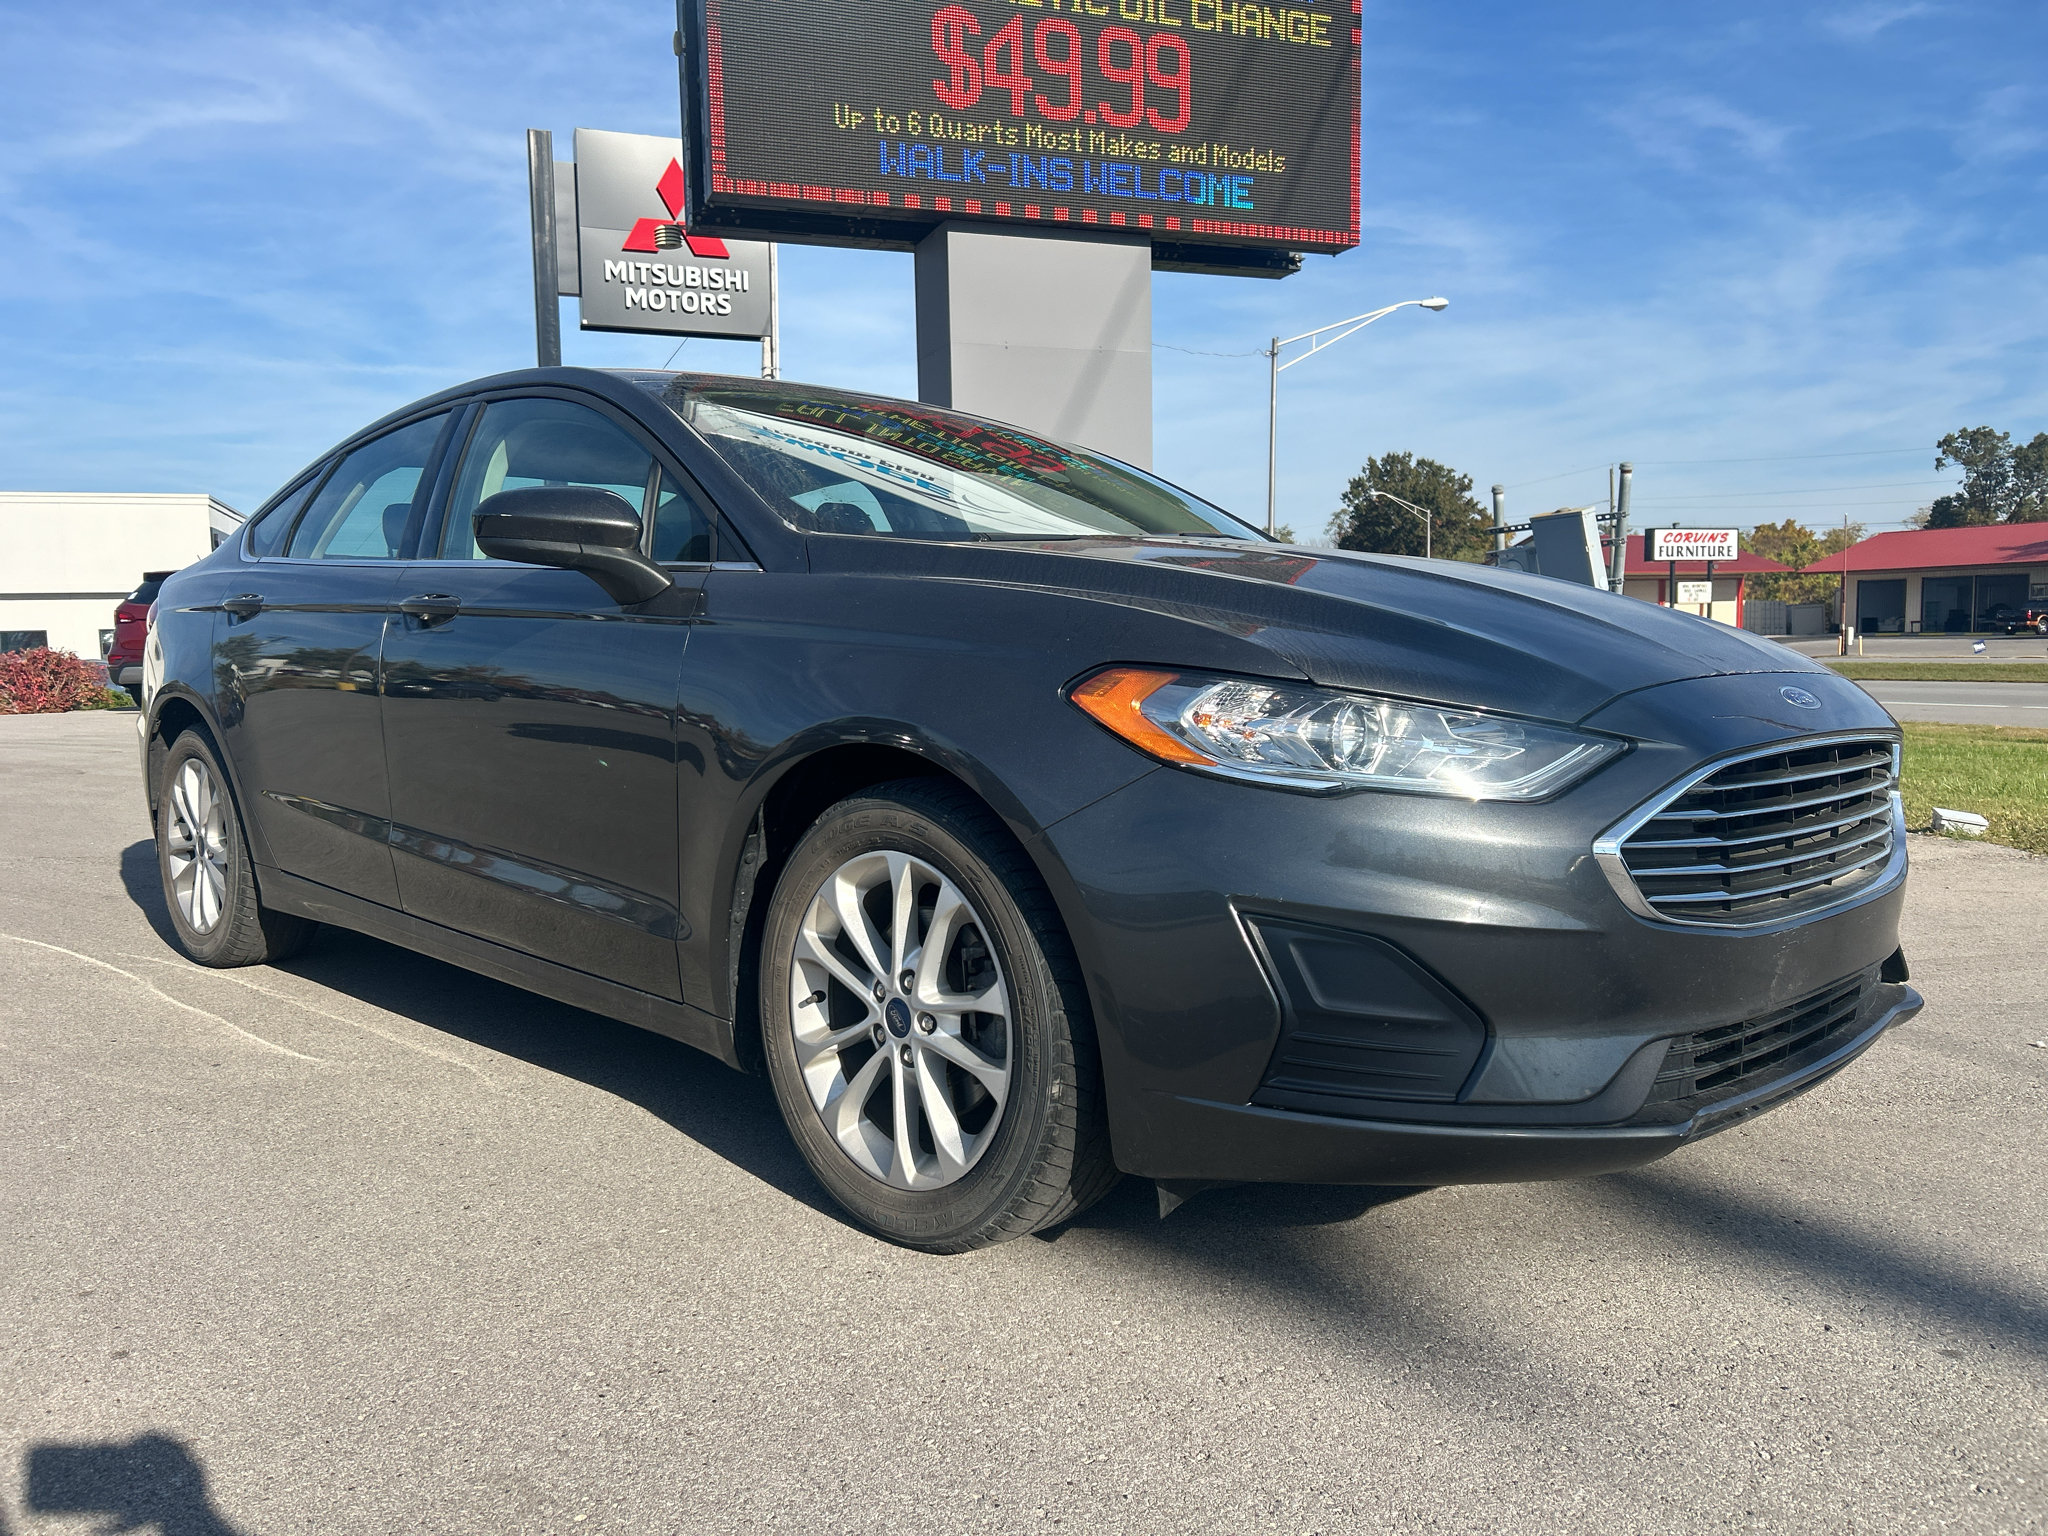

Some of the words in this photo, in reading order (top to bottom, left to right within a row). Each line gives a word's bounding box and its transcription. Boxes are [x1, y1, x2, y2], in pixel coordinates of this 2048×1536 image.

[1190, 0, 1332, 47] CHANGE
[931, 4, 1191, 134] $49.99
[834, 102, 866, 130] Up
[873, 105, 901, 134] to
[906, 109, 923, 136] 6
[928, 112, 1019, 146] Quarts
[1025, 121, 1083, 152] Most
[1089, 128, 1162, 160] Makes
[1167, 141, 1208, 166] and
[1213, 143, 1287, 173] Models
[879, 139, 1075, 192] WALK-INS
[1083, 159, 1255, 210] WELCOME
[603, 258, 750, 293] MITSUBISHI
[624, 286, 734, 316] MOTORS
[1658, 545, 1734, 557] FURNITURE
